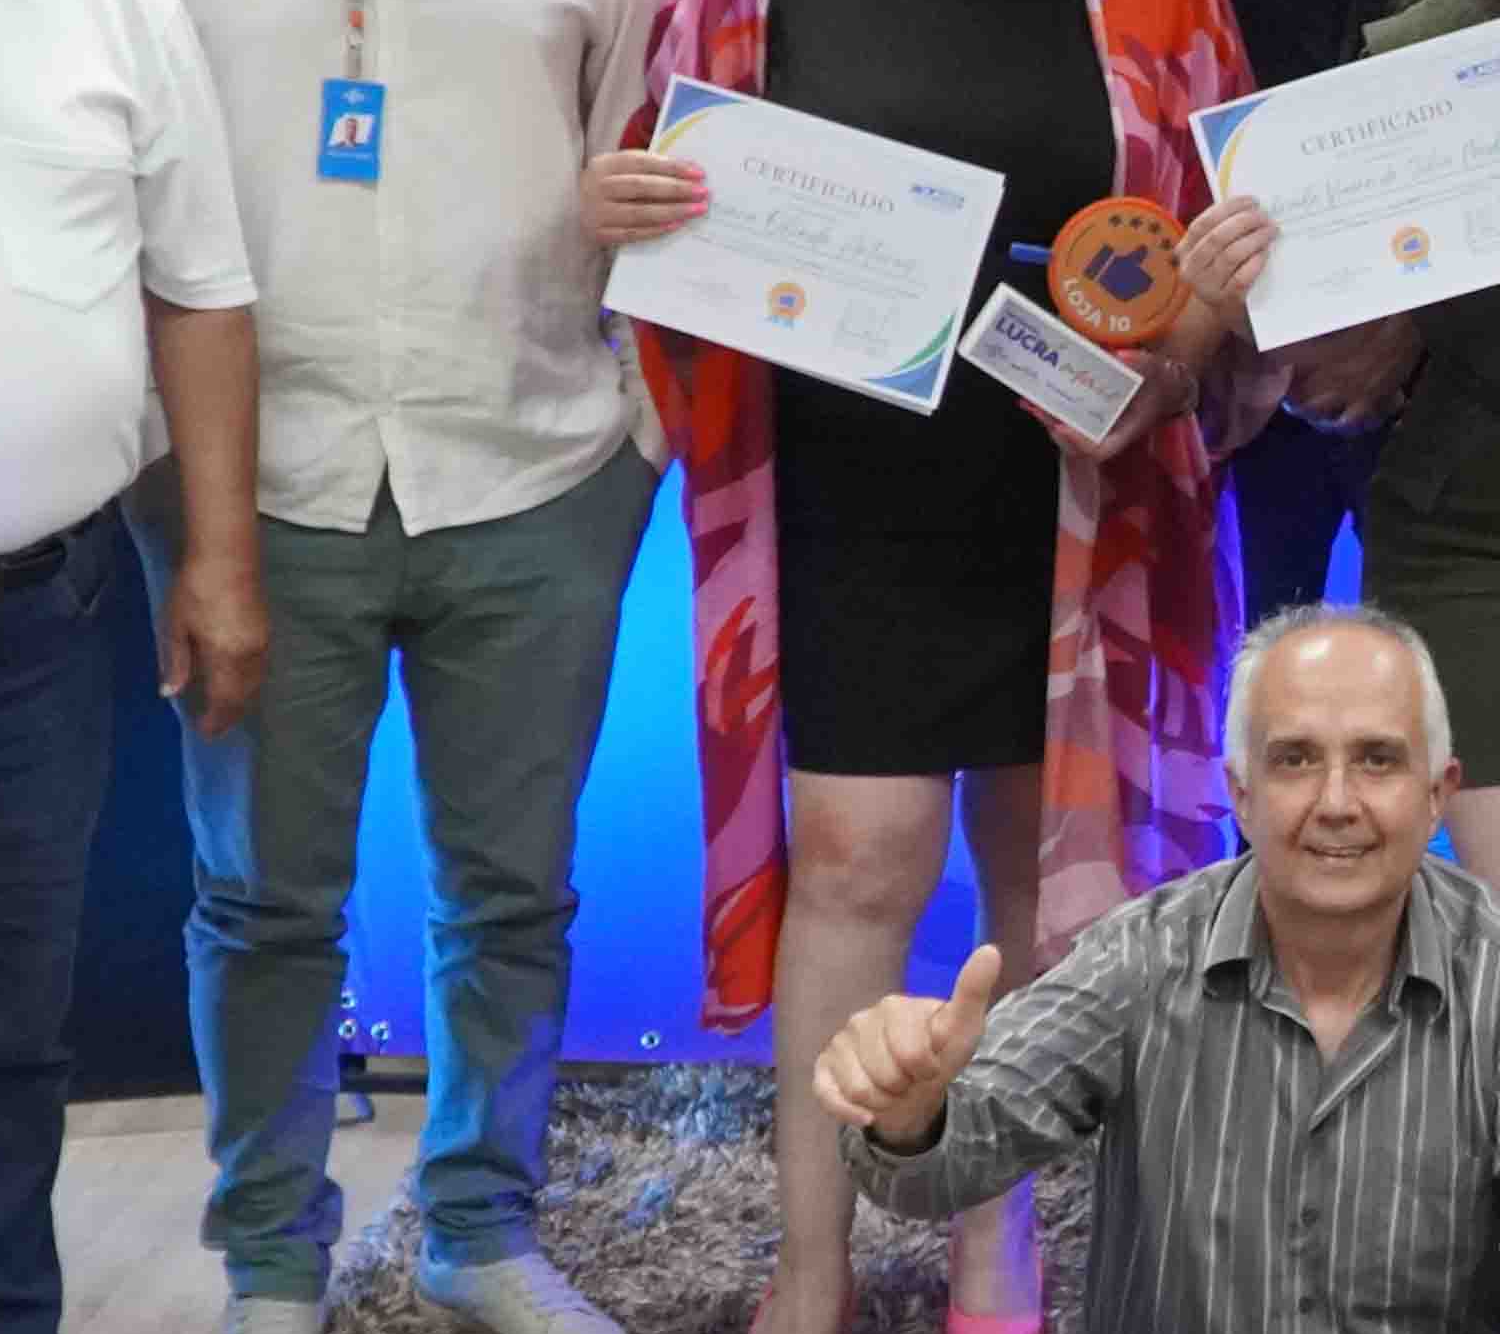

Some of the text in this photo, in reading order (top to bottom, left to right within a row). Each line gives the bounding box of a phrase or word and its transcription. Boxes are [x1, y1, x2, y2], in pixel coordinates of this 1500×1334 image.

[1300, 98, 1454, 158] CERTIFICADO
[740, 154, 898, 213] CERTIFICADO
[1061, 276, 1101, 328] LOJA
[1108, 315, 1132, 333] 10
[994, 315, 1061, 367] LUCRA
